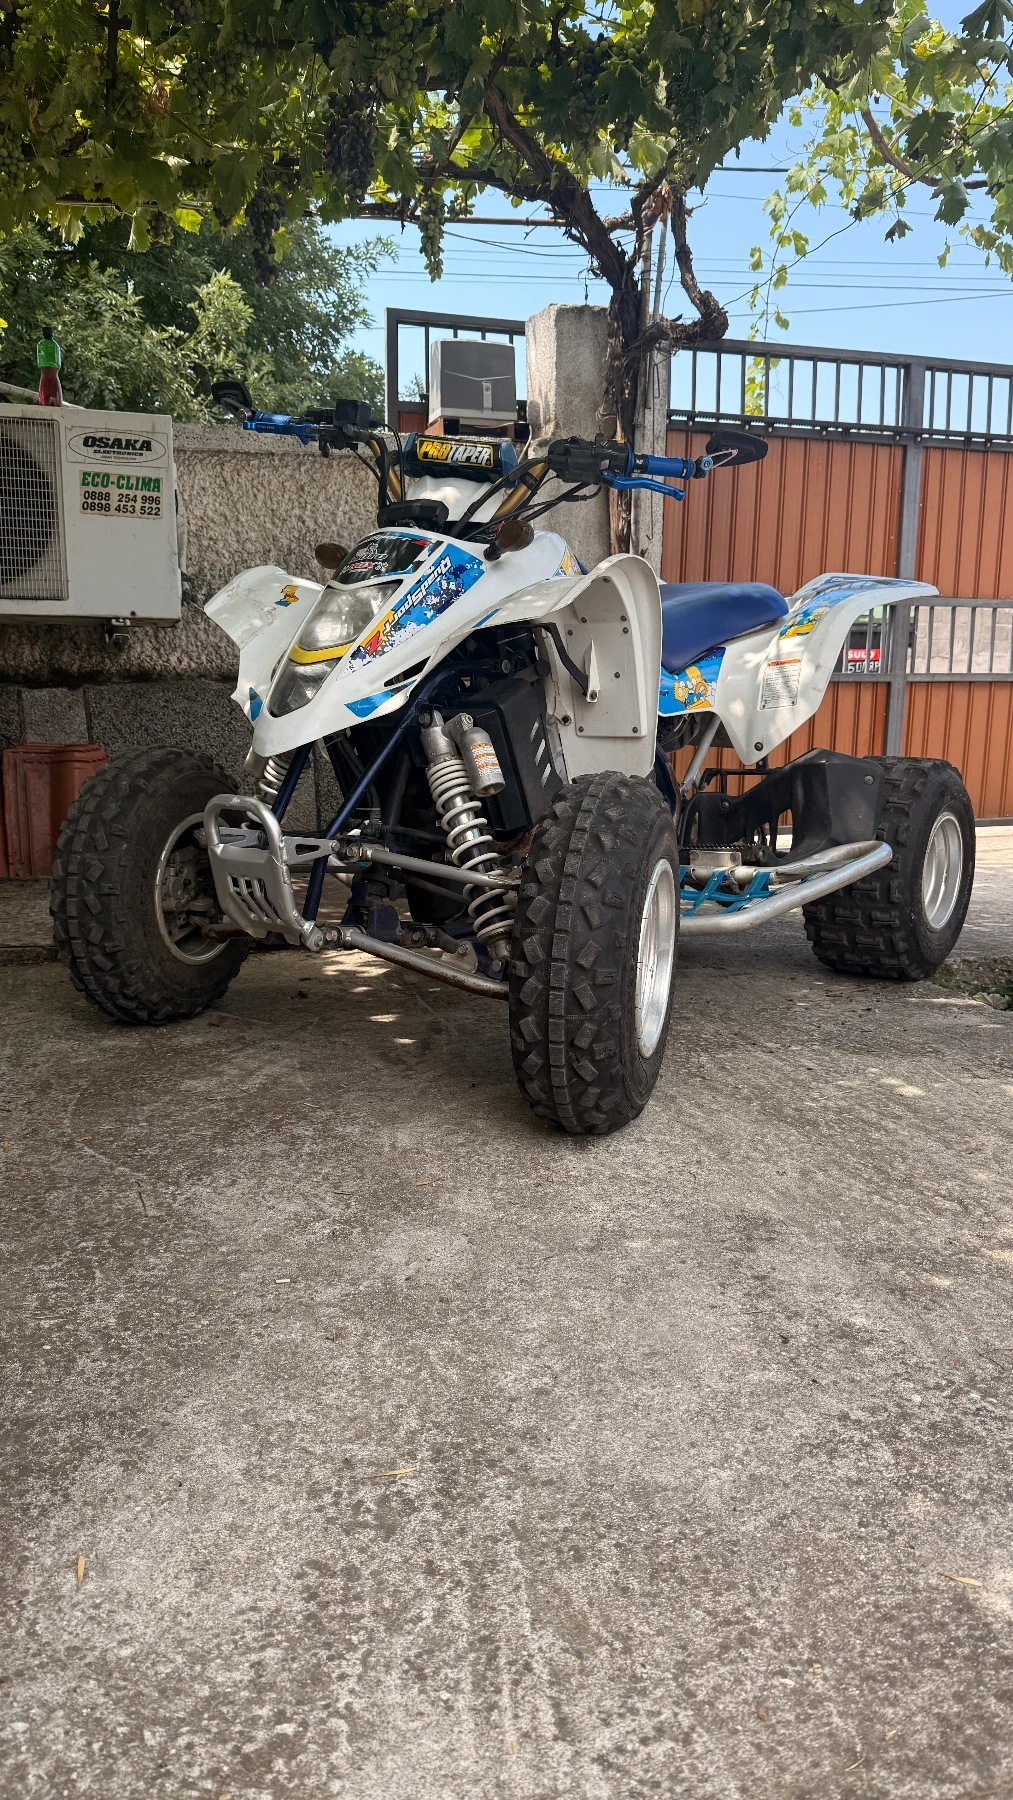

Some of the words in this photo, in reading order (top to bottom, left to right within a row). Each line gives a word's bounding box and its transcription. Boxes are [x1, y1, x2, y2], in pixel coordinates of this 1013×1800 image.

[83, 436, 152, 451] OSAKA
[93, 449, 144, 457] ELECTRONICS
[81, 472, 160, 493] ECO-CLIMA
[83, 490, 111, 502] 0888
[117, 493, 138, 504] 254
[140, 495, 161, 506] 996
[81, 501, 111, 513] 0898
[114, 504, 136, 515] 453
[139, 506, 161, 516] 522
[365, 630, 382, 655] Z
